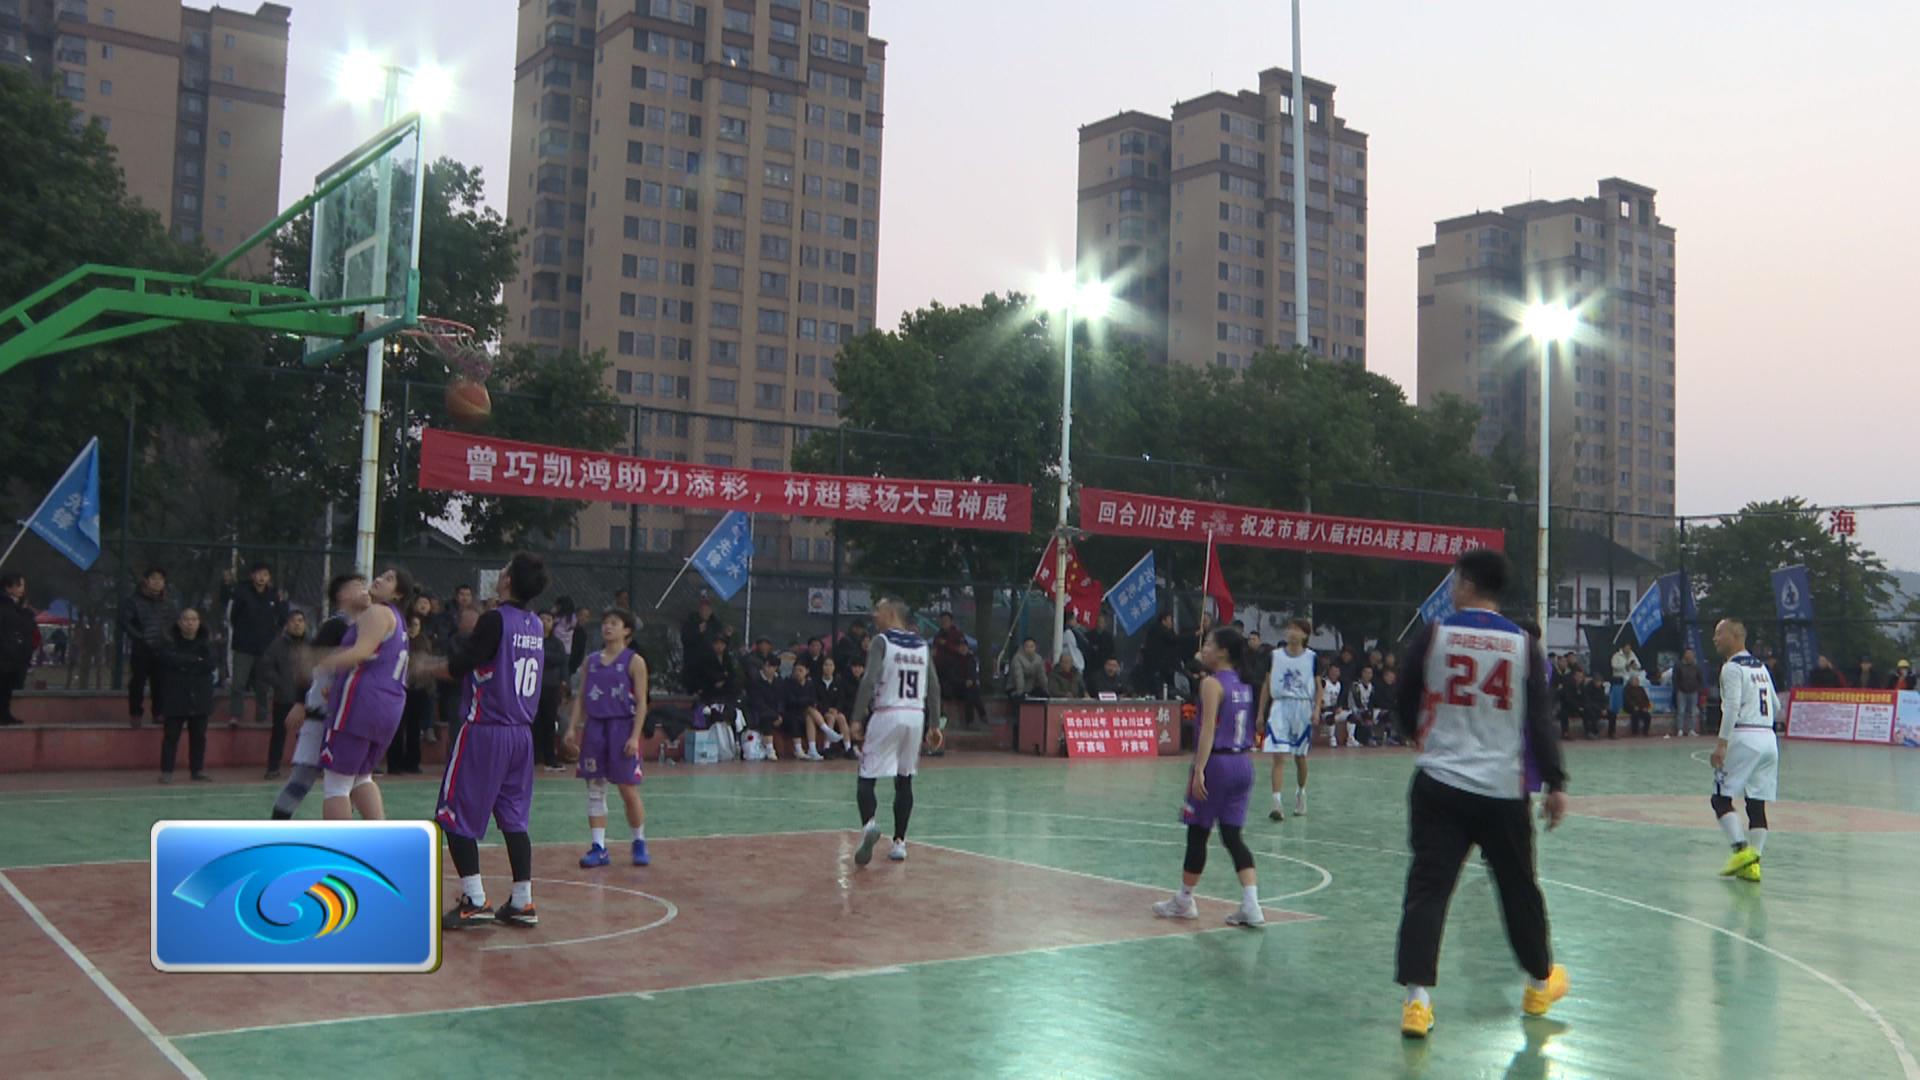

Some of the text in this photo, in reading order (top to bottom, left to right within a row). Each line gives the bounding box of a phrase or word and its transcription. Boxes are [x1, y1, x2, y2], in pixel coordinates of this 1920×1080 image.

[1098, 501, 1196, 531] 回合川过年
[1829, 510, 1856, 536] 海
[514, 657, 539, 697] 16
[899, 669, 919, 699] 19
[1446, 654, 1513, 710] 24
[1759, 688, 1769, 716] 6
